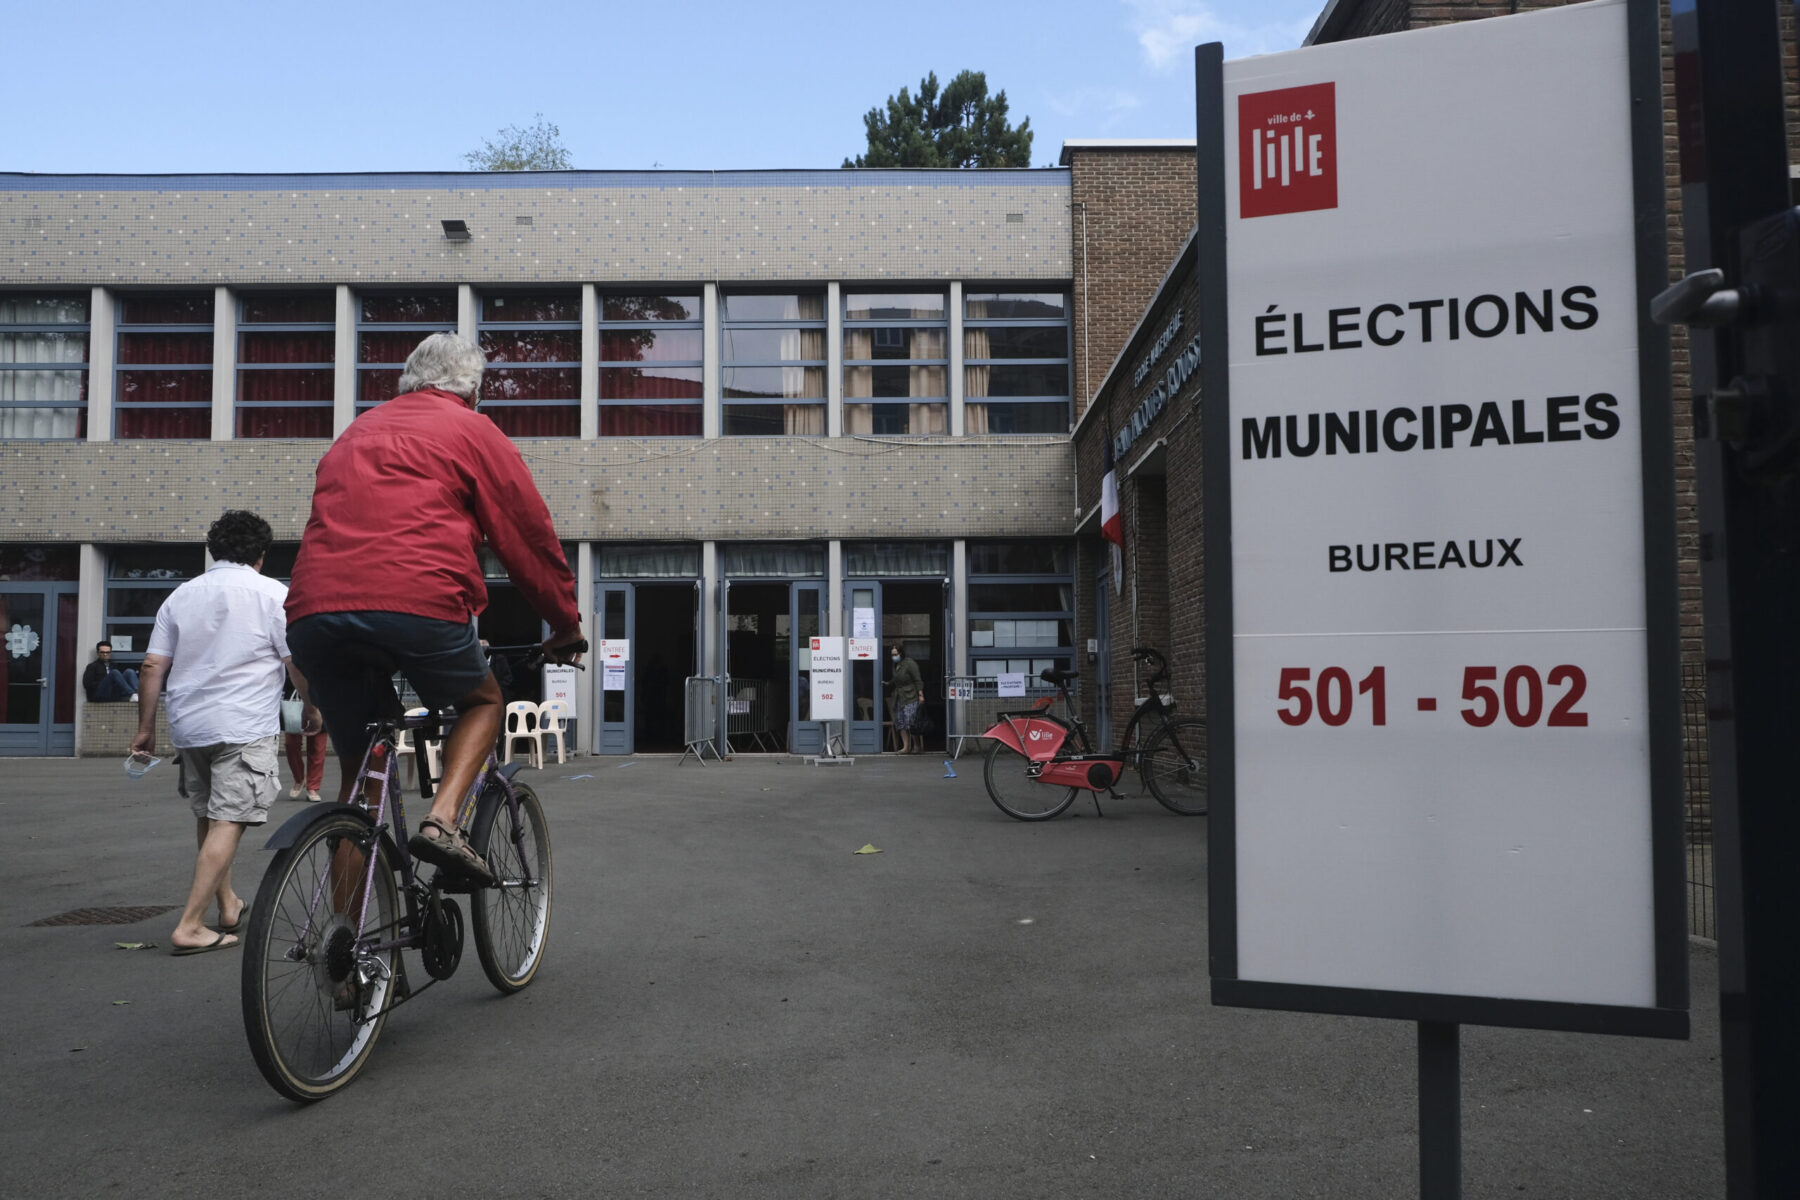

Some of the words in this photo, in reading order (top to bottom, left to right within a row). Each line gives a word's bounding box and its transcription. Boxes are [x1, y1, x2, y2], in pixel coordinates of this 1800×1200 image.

[1267, 112, 1288, 125] ville
[1289, 112, 1302, 122] de
[1254, 285, 1599, 356] ÉLECTIONS
[1241, 392, 1621, 460] MUNICIPALES
[1328, 538, 1524, 572] BUREAUX
[1276, 665, 1386, 726] 501
[1417, 697, 1437, 712] -
[1460, 664, 1588, 728] 502
